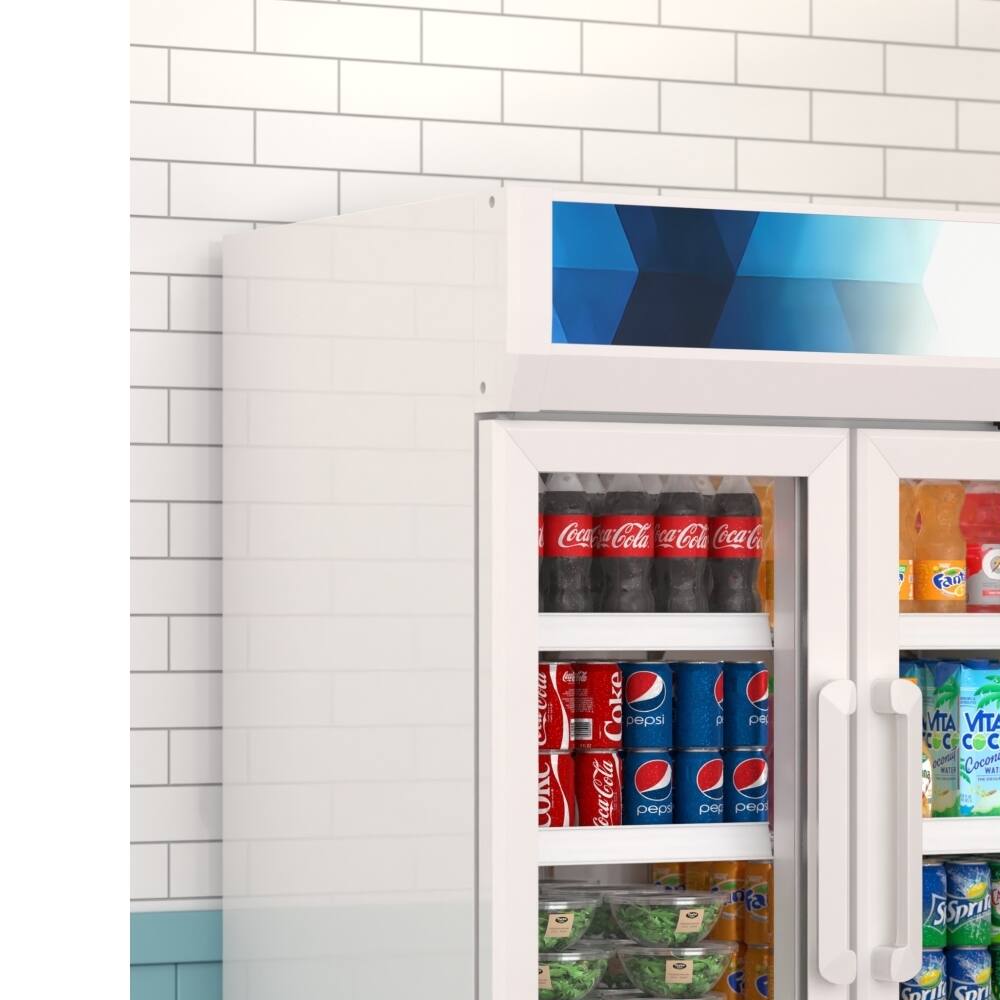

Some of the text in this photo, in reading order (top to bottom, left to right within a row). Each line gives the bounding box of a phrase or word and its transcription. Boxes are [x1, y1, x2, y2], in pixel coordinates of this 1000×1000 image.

[557, 521, 593, 549] Coca
[603, 671, 622, 742] Coke
[626, 714, 665, 727] pepsi
[928, 709, 956, 732] VITA
[933, 747, 957, 768] oconut
